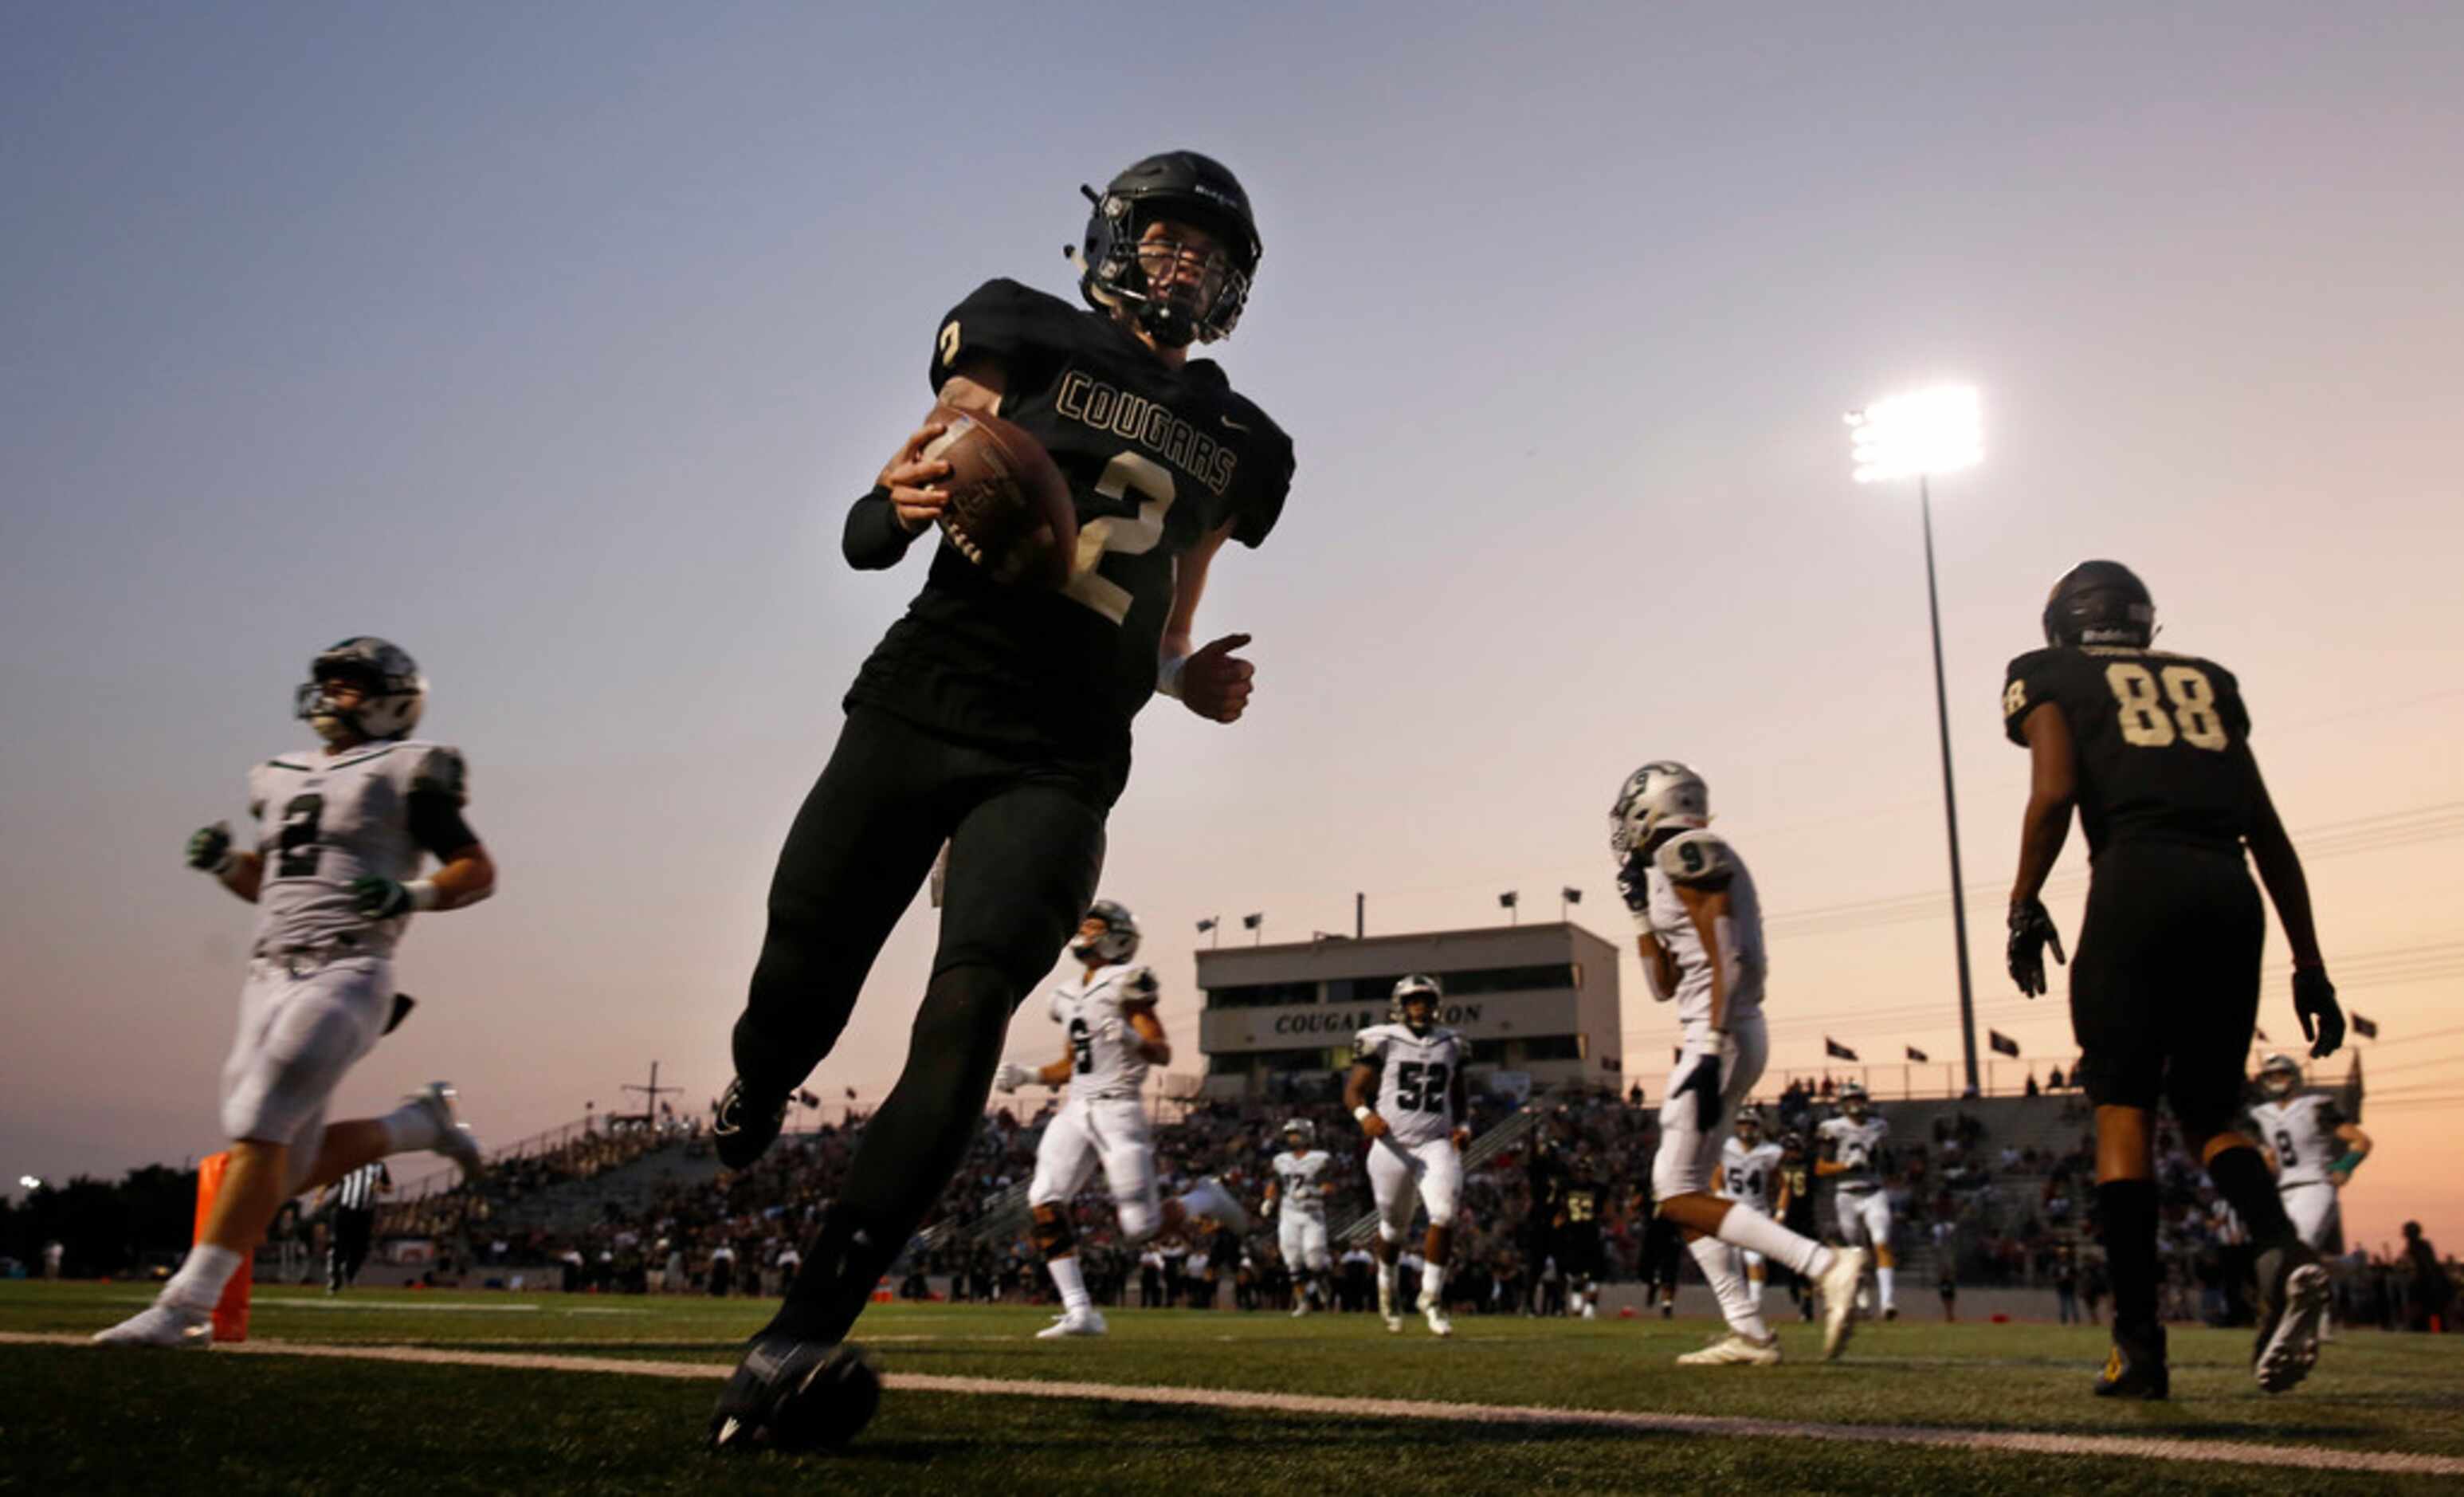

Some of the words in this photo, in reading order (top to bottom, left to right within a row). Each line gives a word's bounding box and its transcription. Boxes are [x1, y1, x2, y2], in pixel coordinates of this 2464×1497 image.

[1056, 370, 1238, 496] COUGARS
[1061, 450, 1175, 627] 2
[2105, 662, 2229, 752] 88
[280, 793, 321, 877] 2
[1679, 842, 1704, 872] 9
[1275, 1011, 1372, 1035] COUGAR
[1398, 1062, 1447, 1113] 52
[1728, 1167, 1761, 1195] 54
